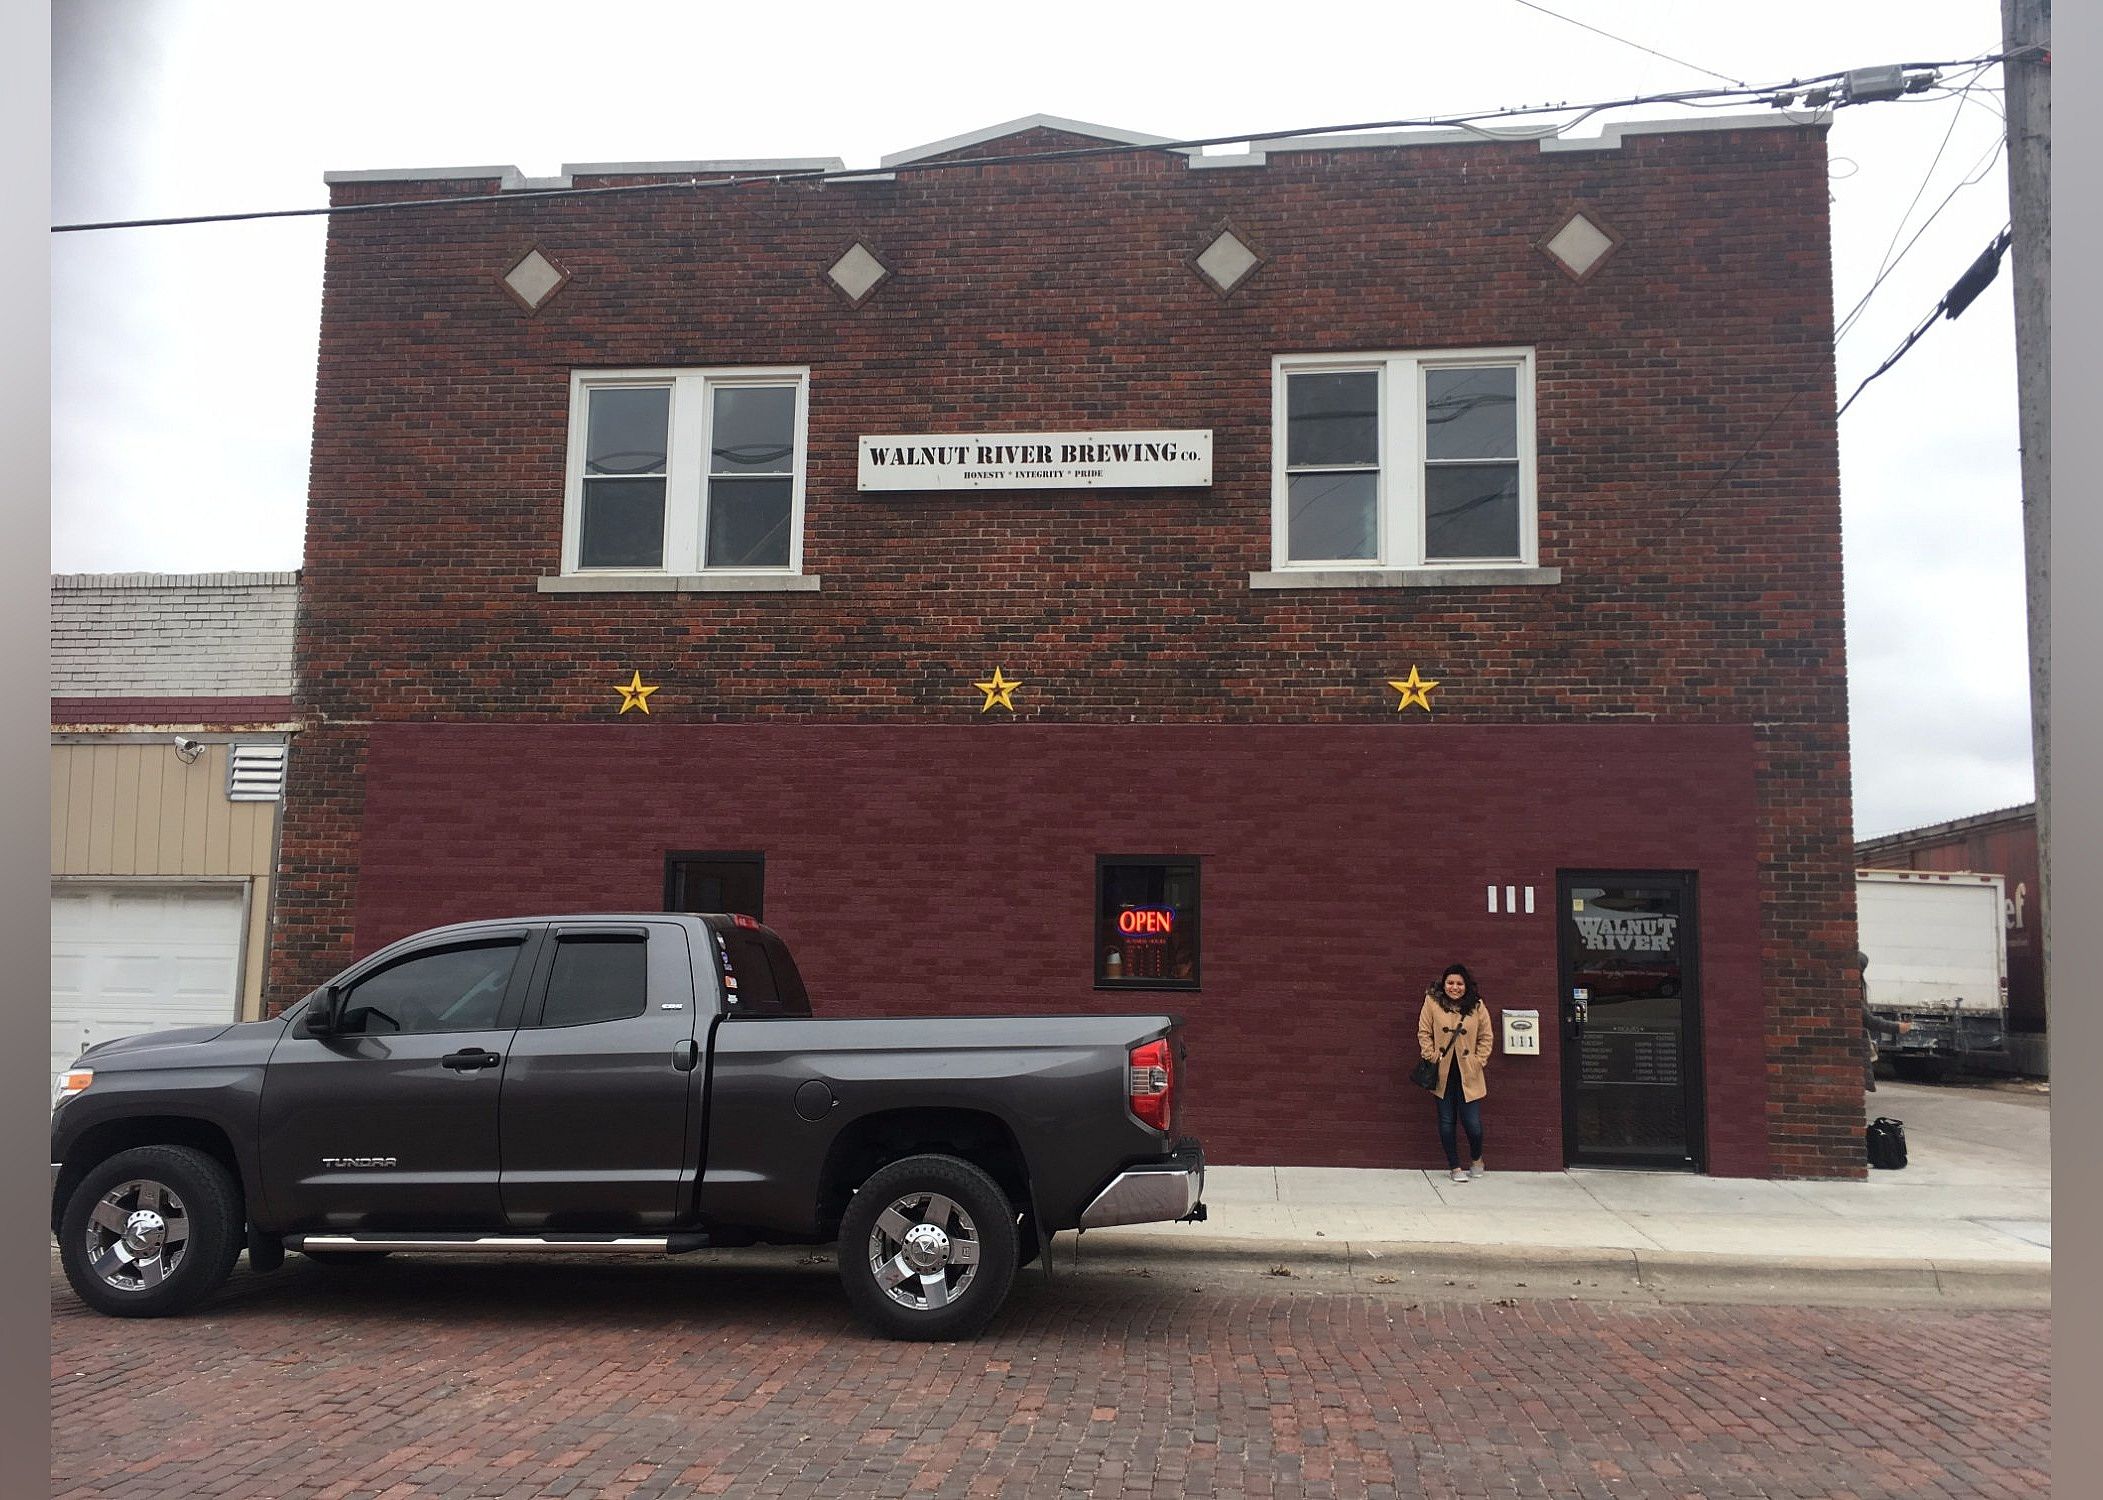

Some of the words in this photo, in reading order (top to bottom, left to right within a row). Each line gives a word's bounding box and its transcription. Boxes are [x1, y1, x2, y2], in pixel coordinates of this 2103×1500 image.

[869, 446, 970, 466] WALNUT
[976, 445, 1053, 465] RIVER
[1060, 442, 1178, 463] BREWING
[963, 471, 1005, 480] HONESTY
[1015, 470, 1064, 479] INTEGRITY
[1074, 469, 1103, 478] PRIDE
[1119, 911, 1171, 932] OPEN
[1574, 917, 1677, 938] WALNUT
[1586, 935, 1671, 951] RIVER
[1510, 1036, 1534, 1047] 111
[322, 1157, 397, 1168] TUNDRA
